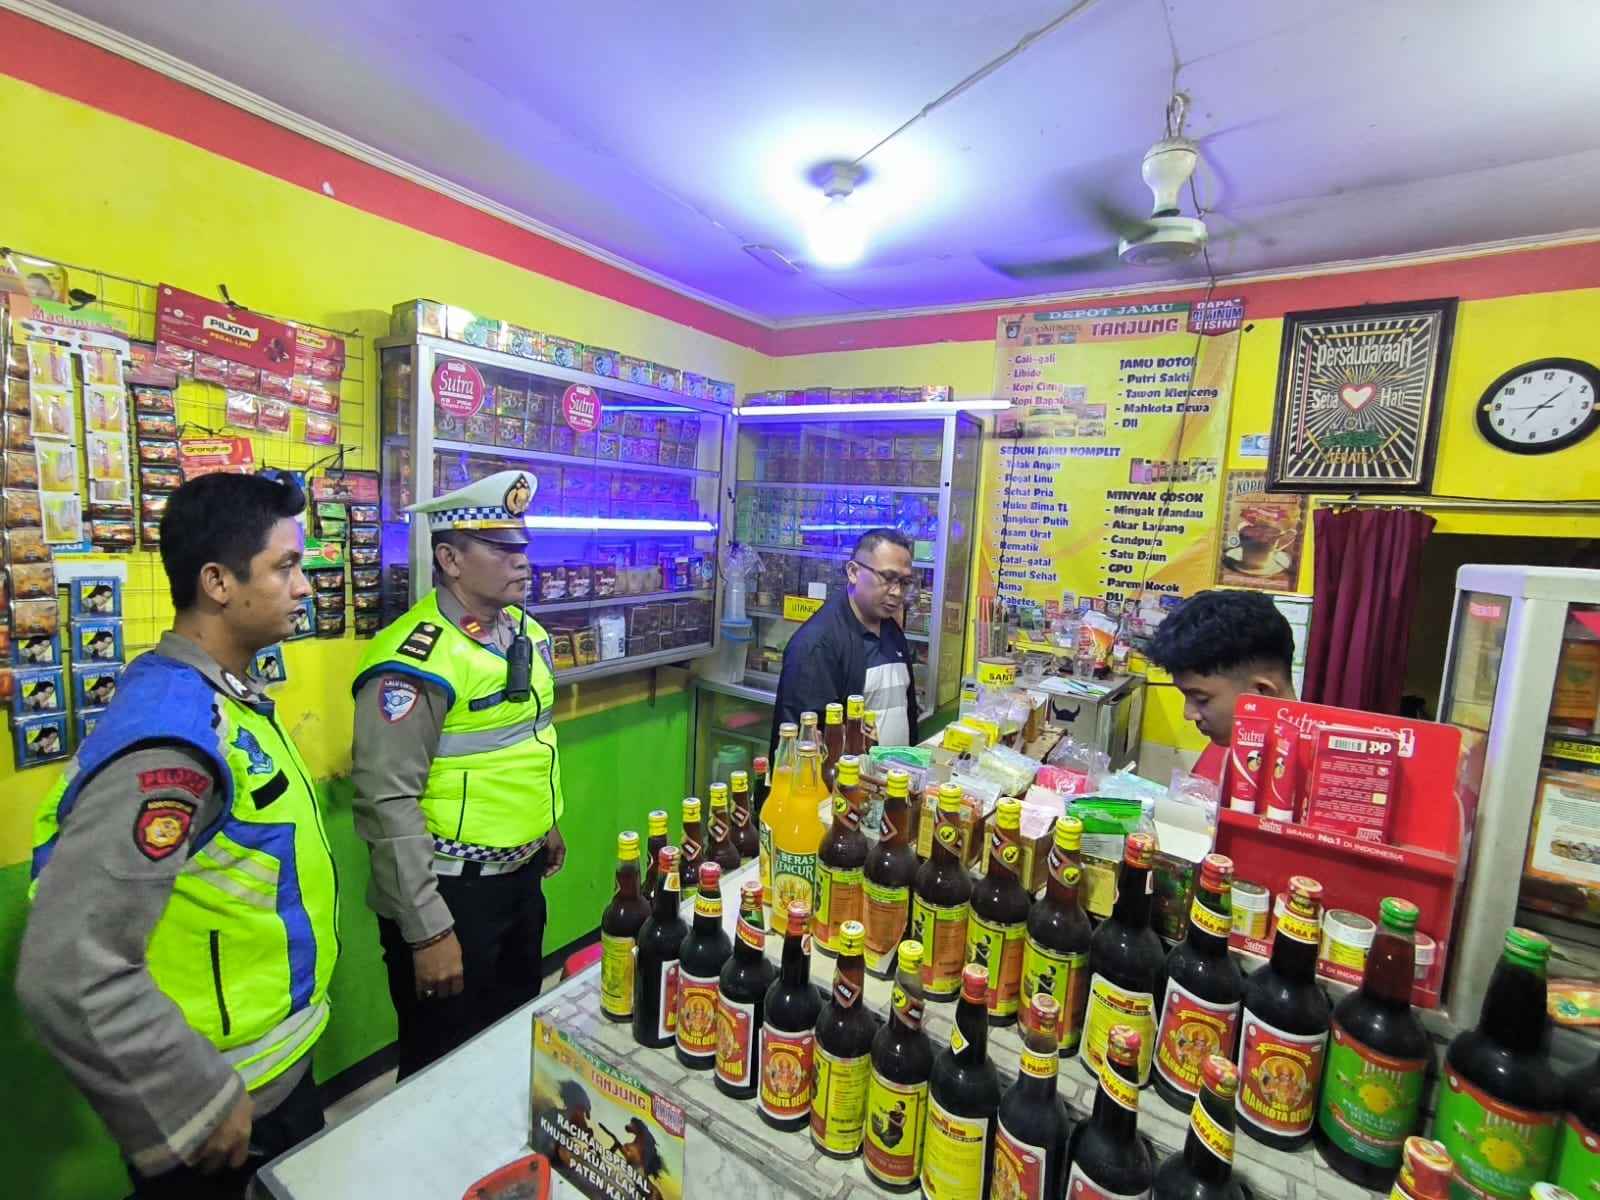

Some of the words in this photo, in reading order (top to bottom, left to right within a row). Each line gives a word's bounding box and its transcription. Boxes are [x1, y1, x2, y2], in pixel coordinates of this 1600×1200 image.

[1049, 307, 1111, 320] DEPOT
[1118, 303, 1173, 315] JAMU
[209, 319, 252, 338] PILKITA
[1092, 318, 1179, 337] TANJUNG
[1119, 358, 1153, 369] JAMU
[439, 369, 474, 394] Sutra
[1126, 374, 1156, 384] Putri
[1160, 372, 1190, 383] Sakti
[1012, 383, 1034, 393] Kopi
[1125, 389, 1161, 399] Tawon
[568, 392, 596, 415] Sutra
[1011, 397, 1032, 406] Kopi
[1123, 403, 1173, 413] Mahkota
[1175, 403, 1210, 413] Dewa
[1000, 446, 1035, 456] SEDUH
[1037, 446, 1067, 456] JAMU
[1032, 460, 1061, 471] Angin
[1033, 474, 1053, 483] Linu
[1033, 488, 1054, 497] Pria
[1106, 490, 1157, 500] MINYAK
[1159, 491, 1204, 502] GOSOK
[1002, 501, 1028, 510] Kuku
[1113, 505, 1155, 516] Minyak
[1042, 516, 1069, 527] Putih
[1112, 520, 1139, 530] Akar
[1000, 527, 1027, 538] Asam
[1029, 529, 1052, 539] Urat
[999, 541, 1040, 552] Rematik
[1109, 549, 1134, 559] Satu
[1029, 570, 1057, 582] Sehat
[999, 581, 1022, 592] Asma
[1107, 577, 1141, 588] Parem
[1145, 581, 1180, 592] Kocok
[1237, 728, 1265, 743] Sutra
[1286, 828, 1315, 840] BRAND
[1318, 833, 1341, 845] No.1
[1343, 840, 1353, 848] DI
[781, 853, 816, 865] BERAS
[591, 1069, 647, 1111] TANJUNG
[1242, 1083, 1288, 1122] MAHKOTA
[541, 1117, 581, 1156] KHUSUS
[583, 1150, 612, 1177] KUAT
[557, 1112, 602, 1154] RACIKAN
[605, 1149, 651, 1194] SPESIAL
[569, 1158, 604, 1189] PATEN
